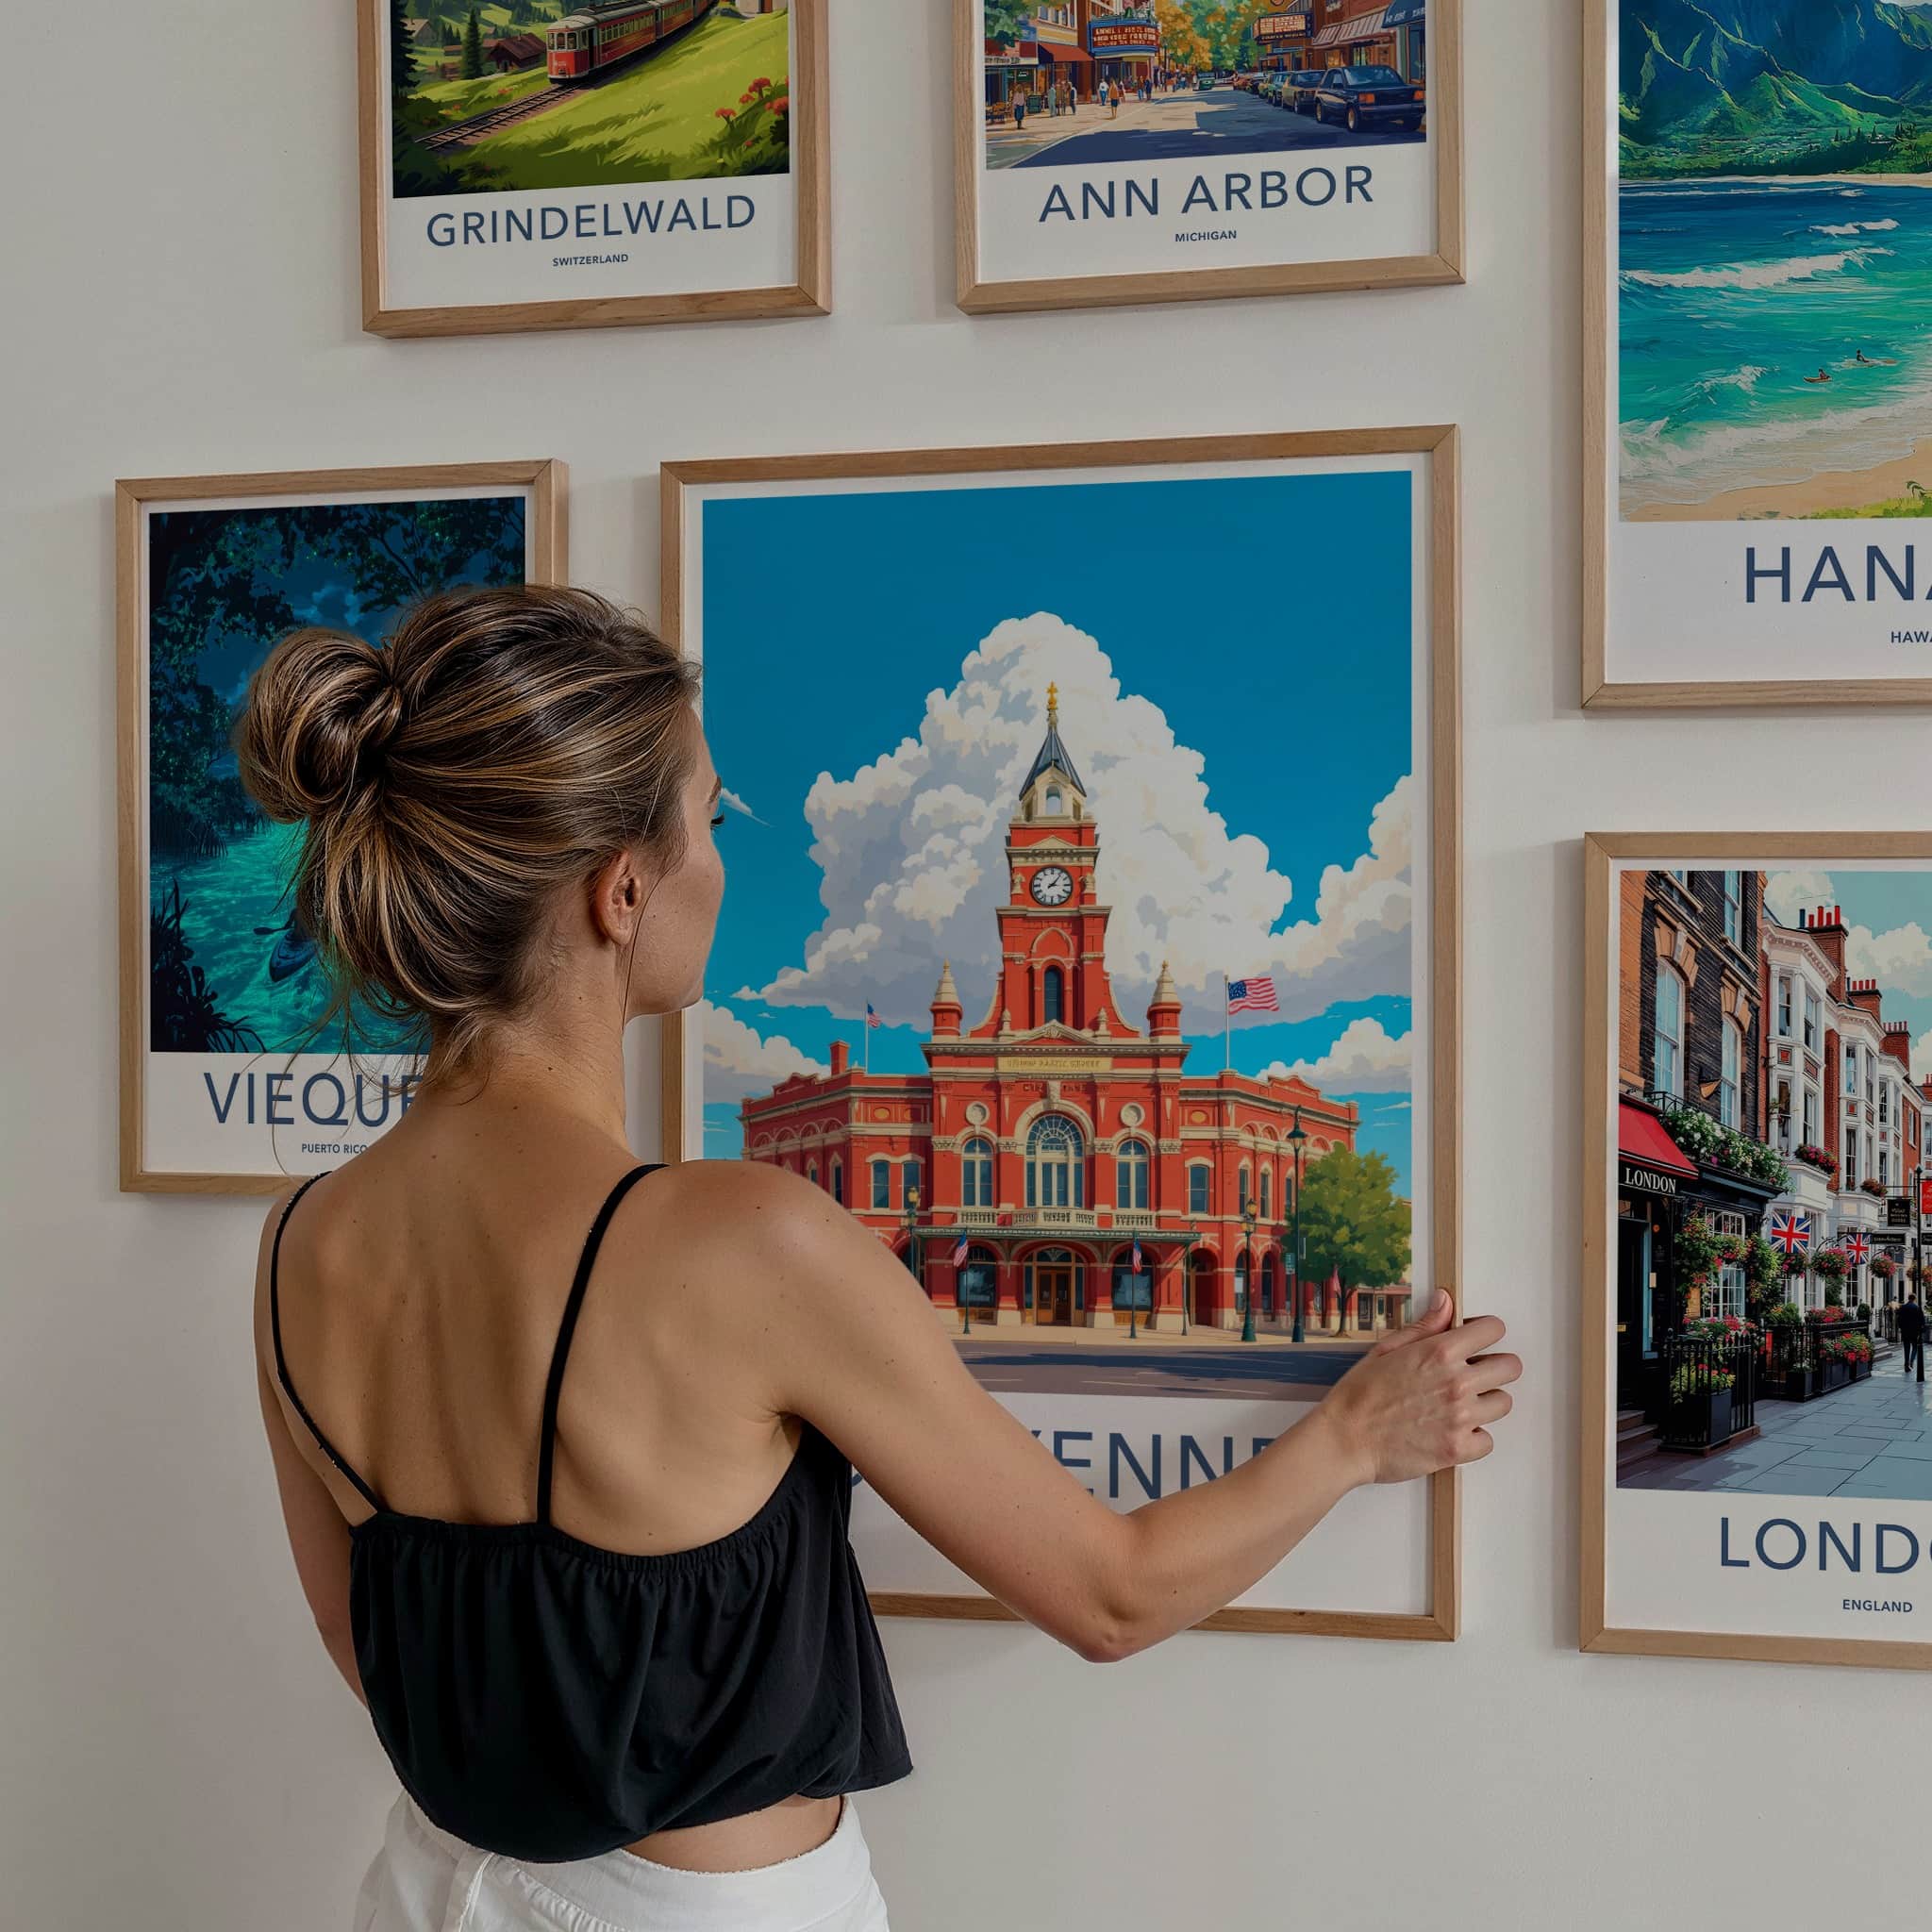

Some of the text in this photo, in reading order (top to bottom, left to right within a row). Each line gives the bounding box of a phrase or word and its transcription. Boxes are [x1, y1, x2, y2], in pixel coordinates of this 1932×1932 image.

[1039, 165, 1374, 223] ANN ARBOR
[426, 194, 756, 247] GRINDELWALD
[1174, 229, 1238, 242] MICHIGAN
[552, 254, 629, 267] SWITZERLAND
[1745, 544, 1932, 604] HAN
[1890, 630, 1932, 643] HAW
[301, 1143, 341, 1154] PUERTO
[1624, 1167, 1676, 1194] LONDON
[1721, 1517, 1932, 1574] LOND
[1842, 1599, 1913, 1613] ENGLAND
